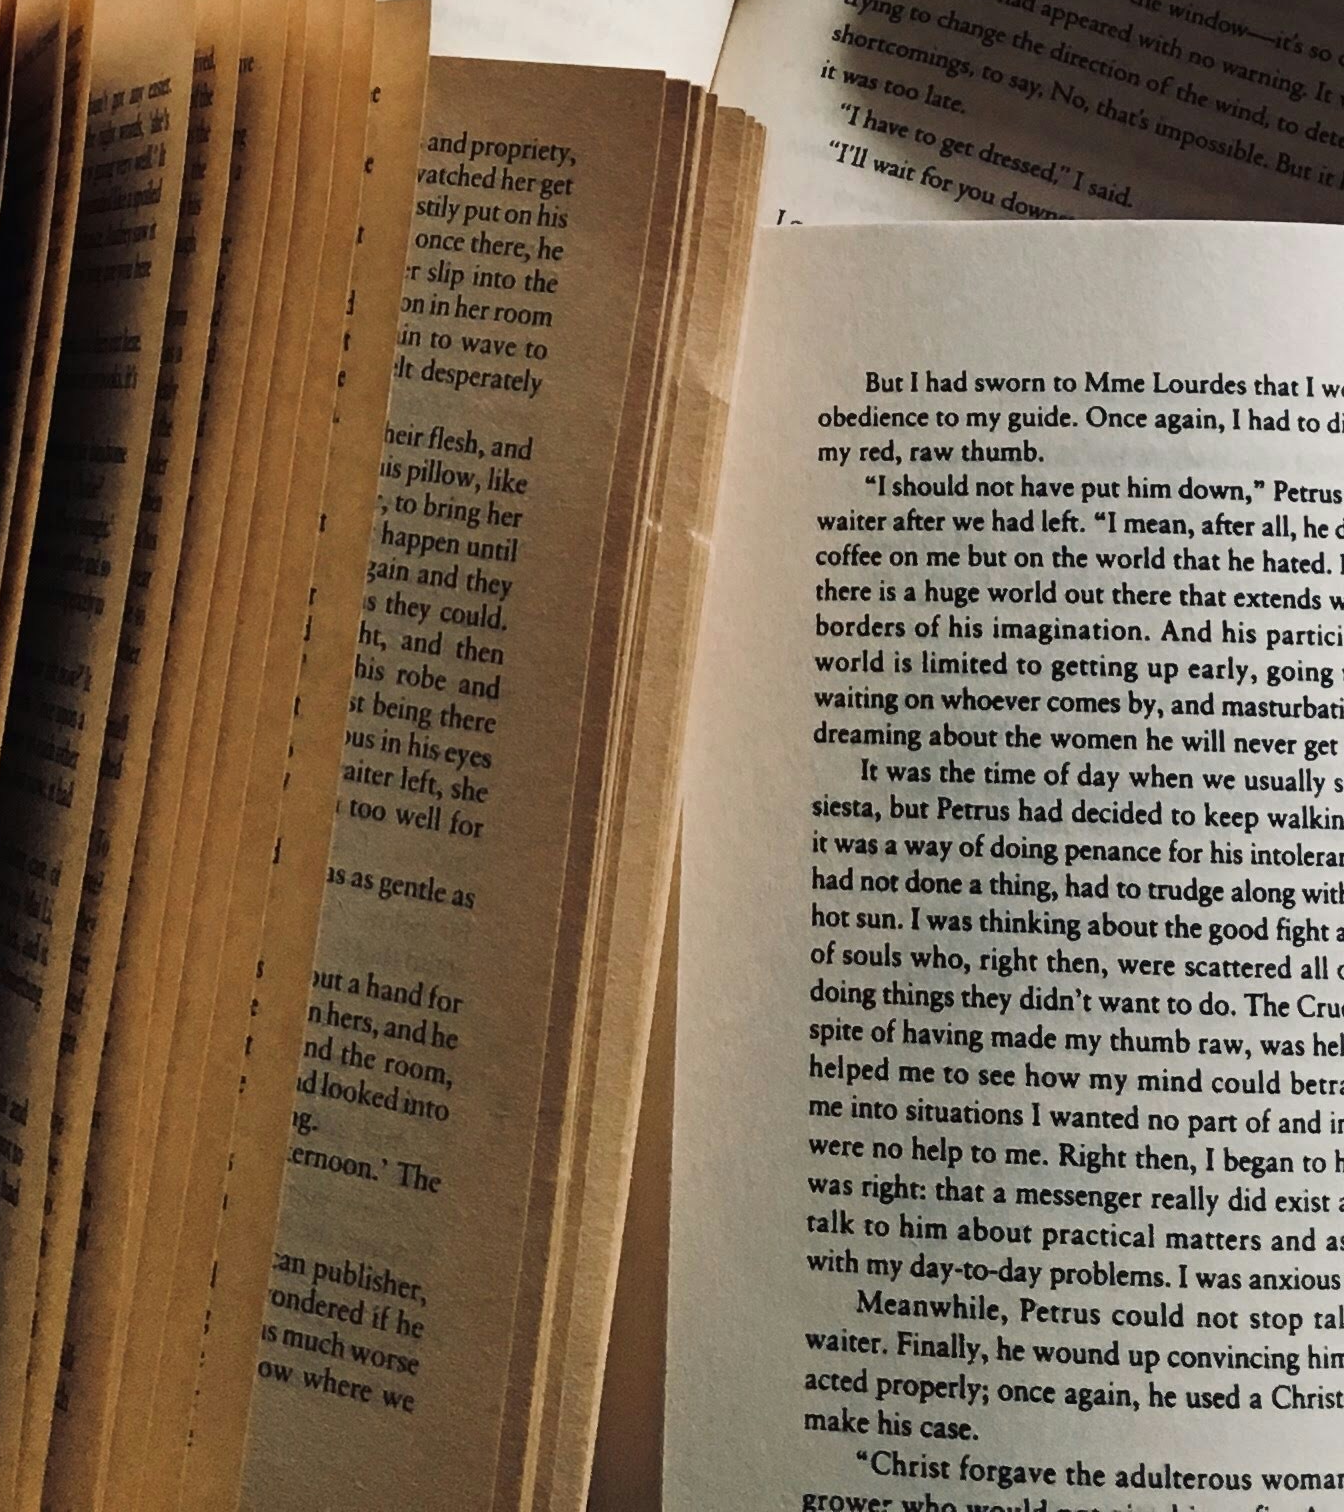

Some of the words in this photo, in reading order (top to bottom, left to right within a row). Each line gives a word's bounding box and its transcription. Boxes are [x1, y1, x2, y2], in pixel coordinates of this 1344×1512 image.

[1167, 1, 1304, 55] window—it’s
[1307, 44, 1333, 62] so
[426, 130, 468, 154] and
[467, 137, 576, 168] propriety,
[414, 232, 465, 252] once
[469, 229, 535, 264] there,
[535, 234, 564, 262] he
[865, 370, 904, 393] But
[909, 370, 918, 392] I
[924, 369, 968, 393] had
[973, 376, 1045, 393] sworn
[1052, 375, 1077, 393] to
[1083, 370, 1145, 393] Mme
[1152, 371, 1247, 396] Lourdes
[1253, 372, 1299, 397] that
[1305, 375, 1314, 398] I
[817, 445, 851, 467] my
[858, 438, 902, 466] red,
[909, 445, 954, 463] raw
[960, 437, 1044, 463] thumb.
[349, 798, 387, 822] too
[394, 804, 442, 831] well
[447, 809, 484, 839] for
